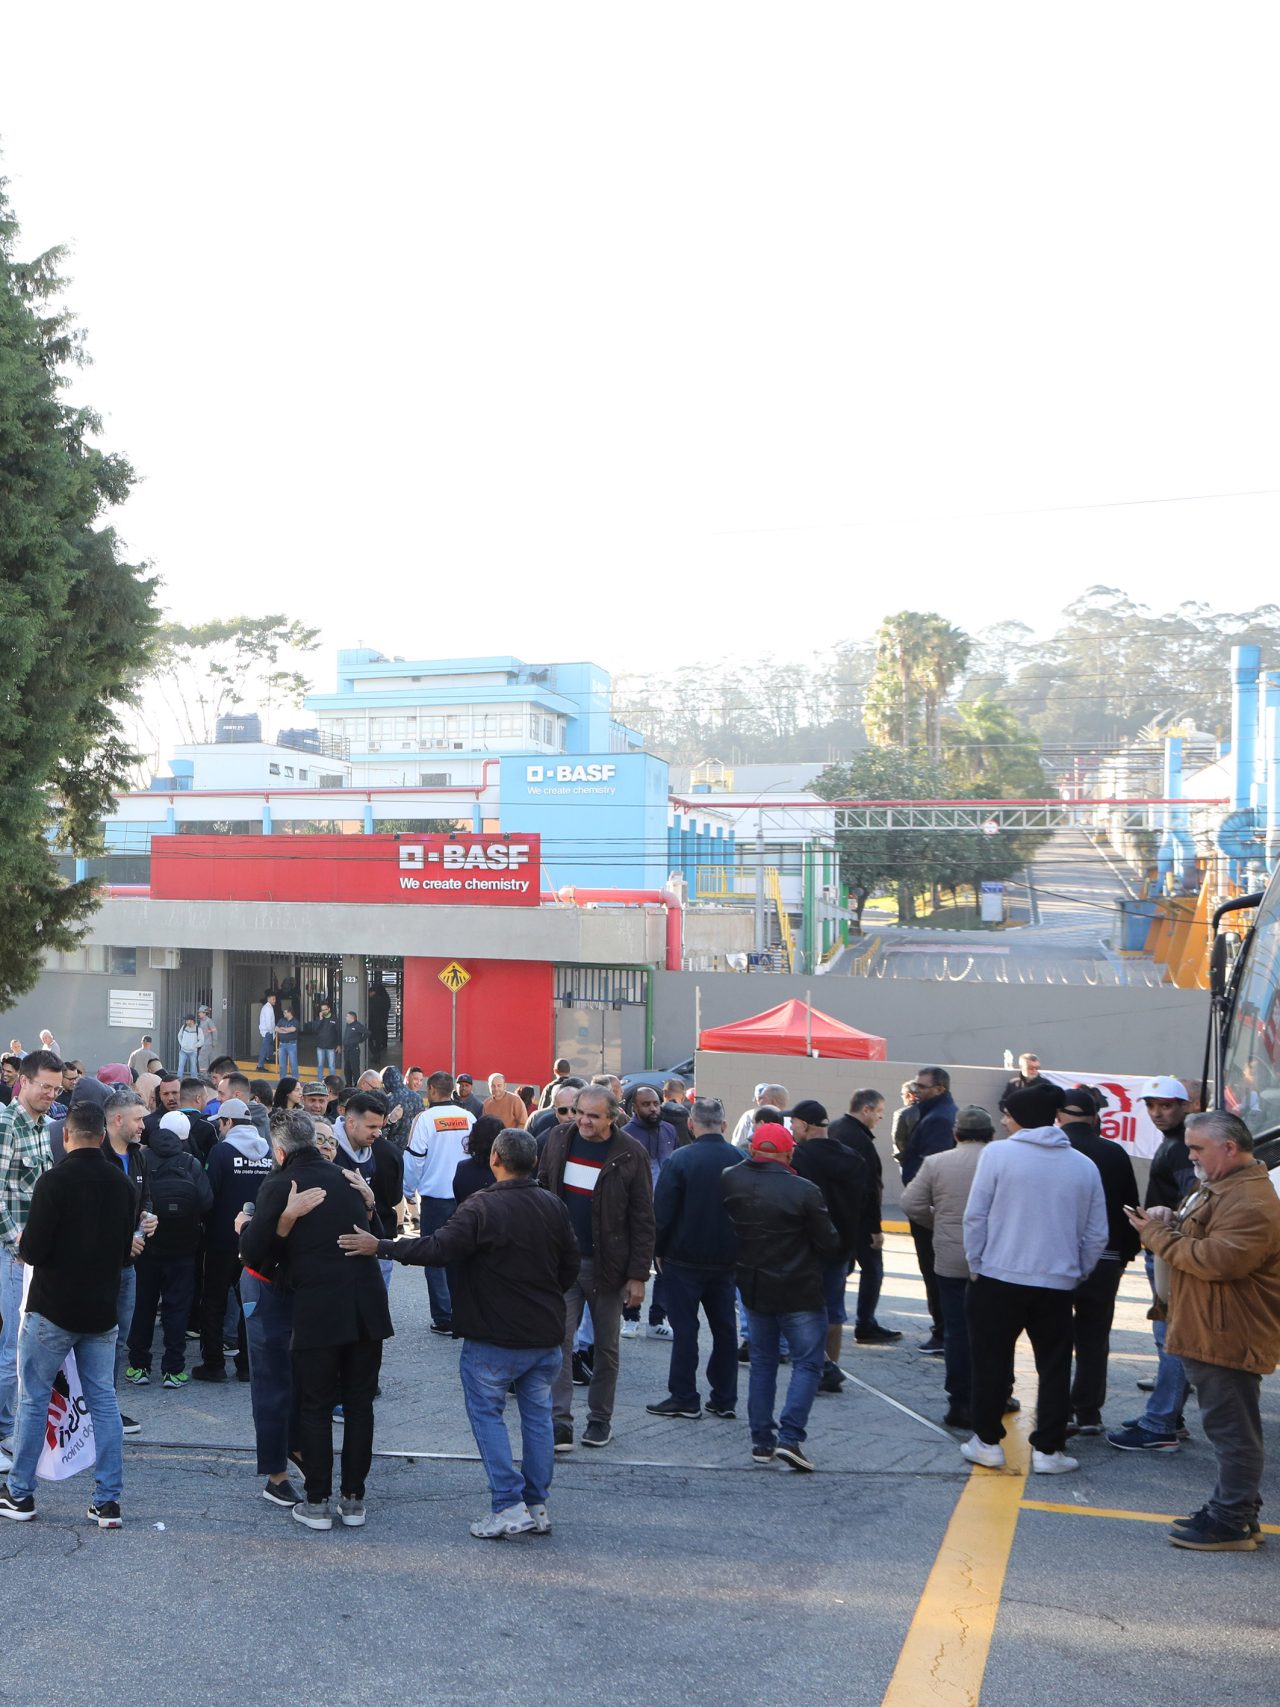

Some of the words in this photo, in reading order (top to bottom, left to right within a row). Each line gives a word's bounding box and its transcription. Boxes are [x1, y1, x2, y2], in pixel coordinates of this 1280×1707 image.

[556, 764, 616, 782] BASF
[527, 786, 542, 795] We
[543, 786, 571, 795] create
[574, 786, 616, 795] chemistry
[443, 844, 530, 870] BASF
[399, 877, 420, 890] We
[422, 878, 462, 890] create
[464, 877, 529, 893] chemistry
[439, 1119, 467, 1128] Suvinil
